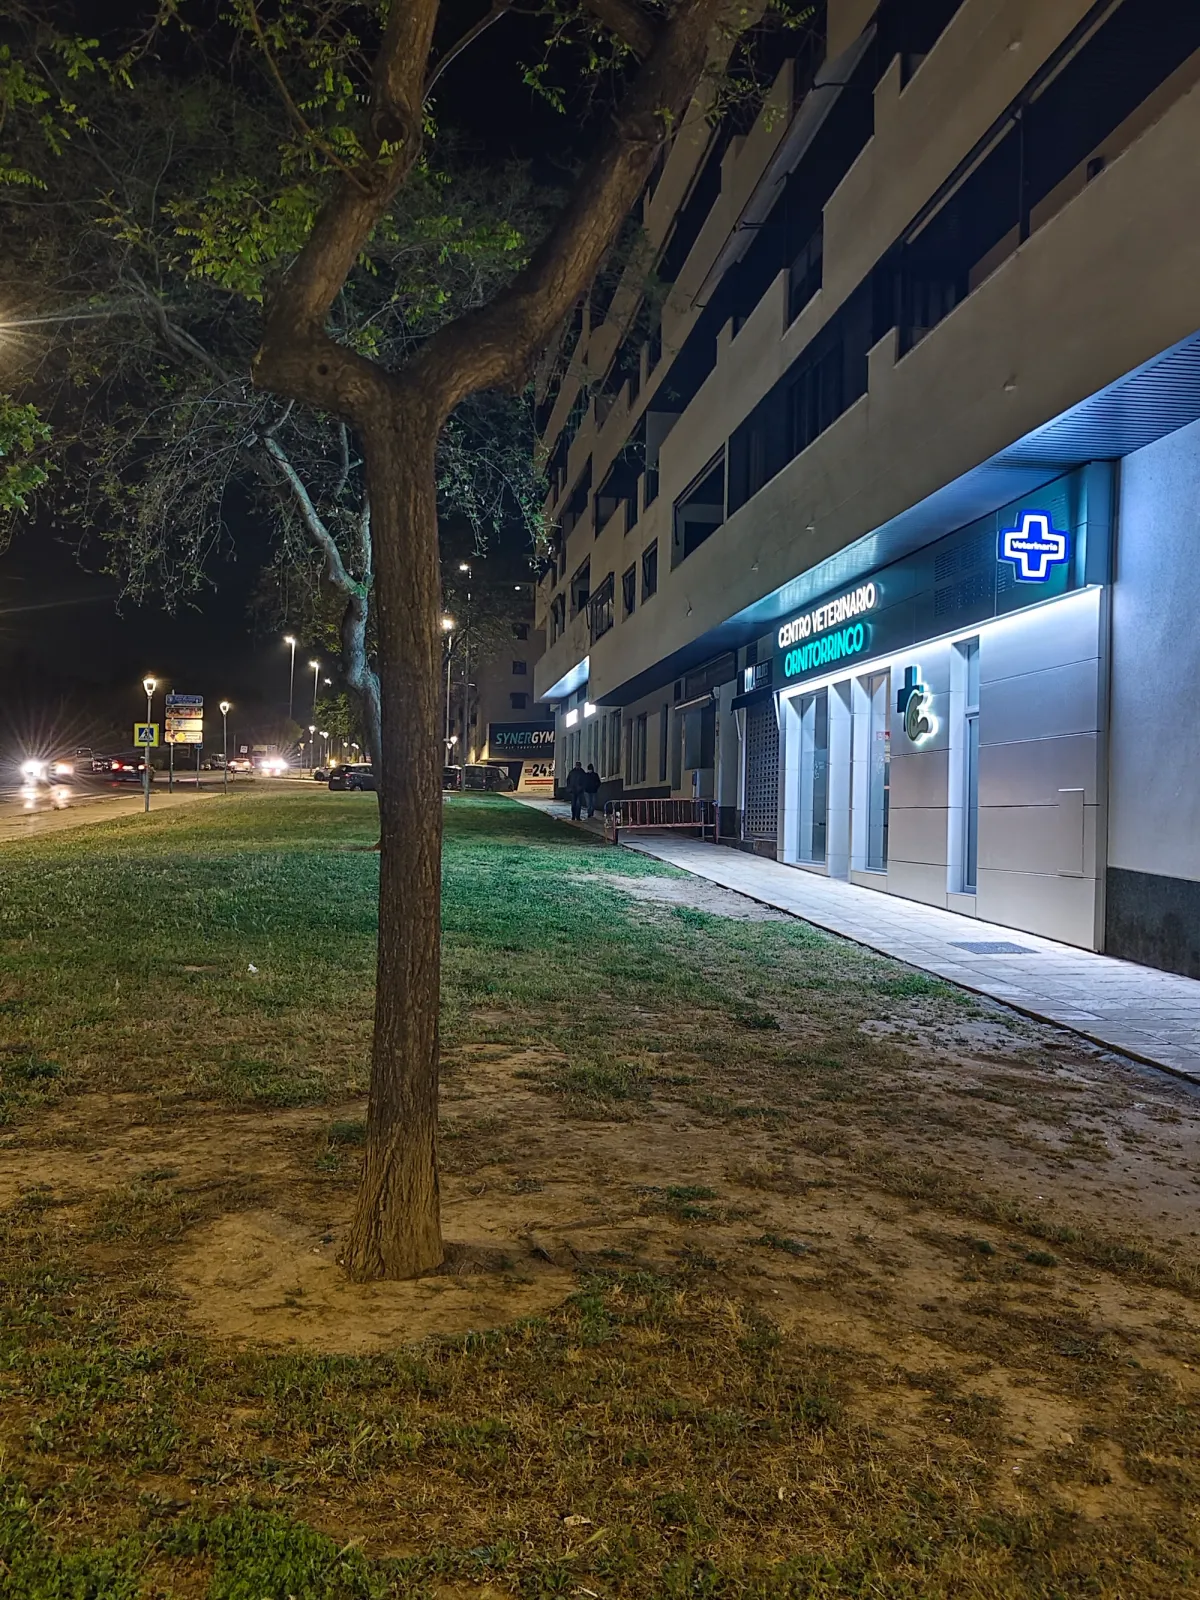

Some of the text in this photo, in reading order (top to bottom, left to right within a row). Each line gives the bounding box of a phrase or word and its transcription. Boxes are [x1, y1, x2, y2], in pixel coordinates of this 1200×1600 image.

[778, 582, 876, 648] CENTRO VETERINARIO
[784, 623, 864, 677] ORNITORRINCO
[495, 730, 555, 745] SYNERGYM
